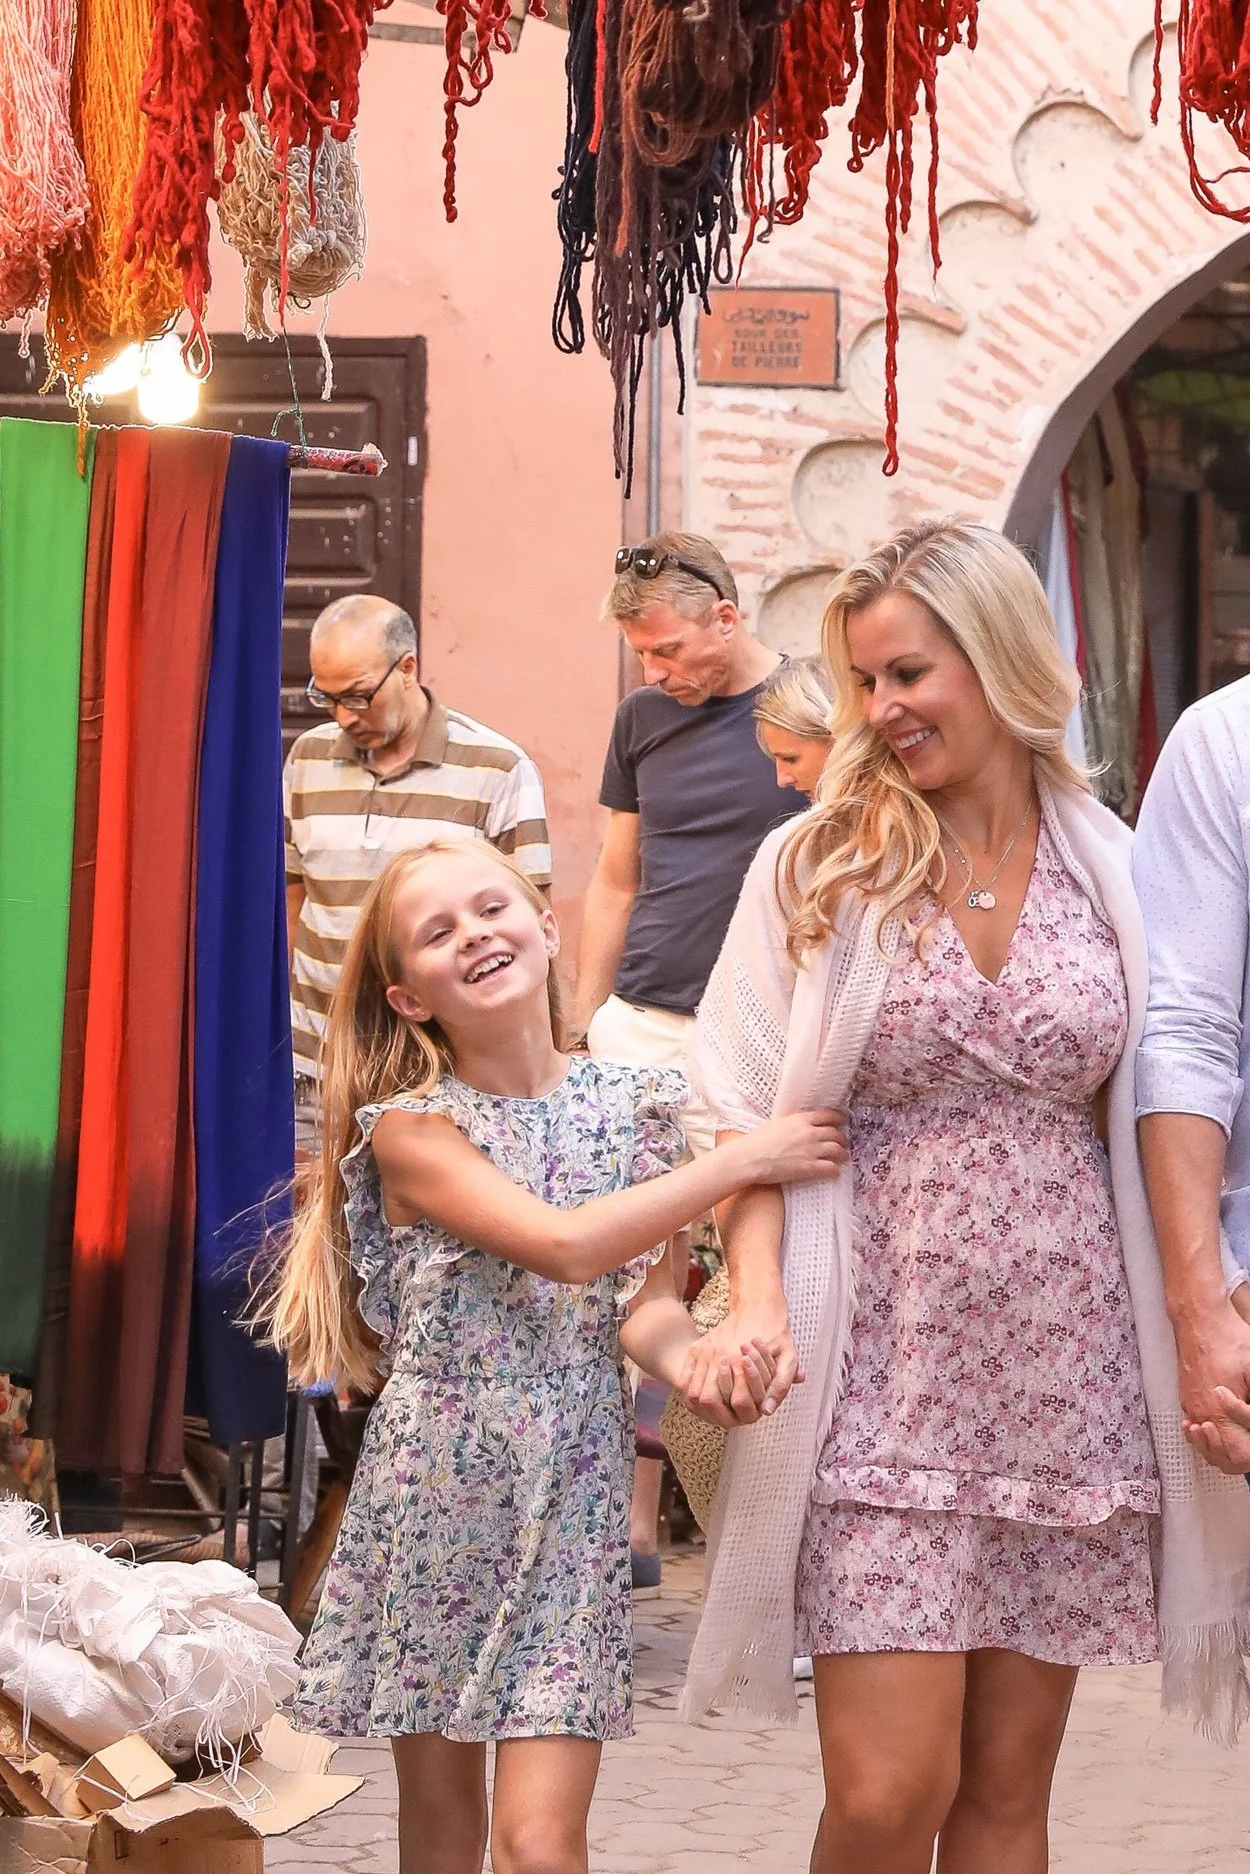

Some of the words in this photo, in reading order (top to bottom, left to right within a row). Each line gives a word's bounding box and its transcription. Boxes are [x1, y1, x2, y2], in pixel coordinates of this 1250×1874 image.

[732, 341, 802, 354] TAILLEURS
[732, 356, 747, 368] DE
[754, 356, 800, 368] PIERRE
